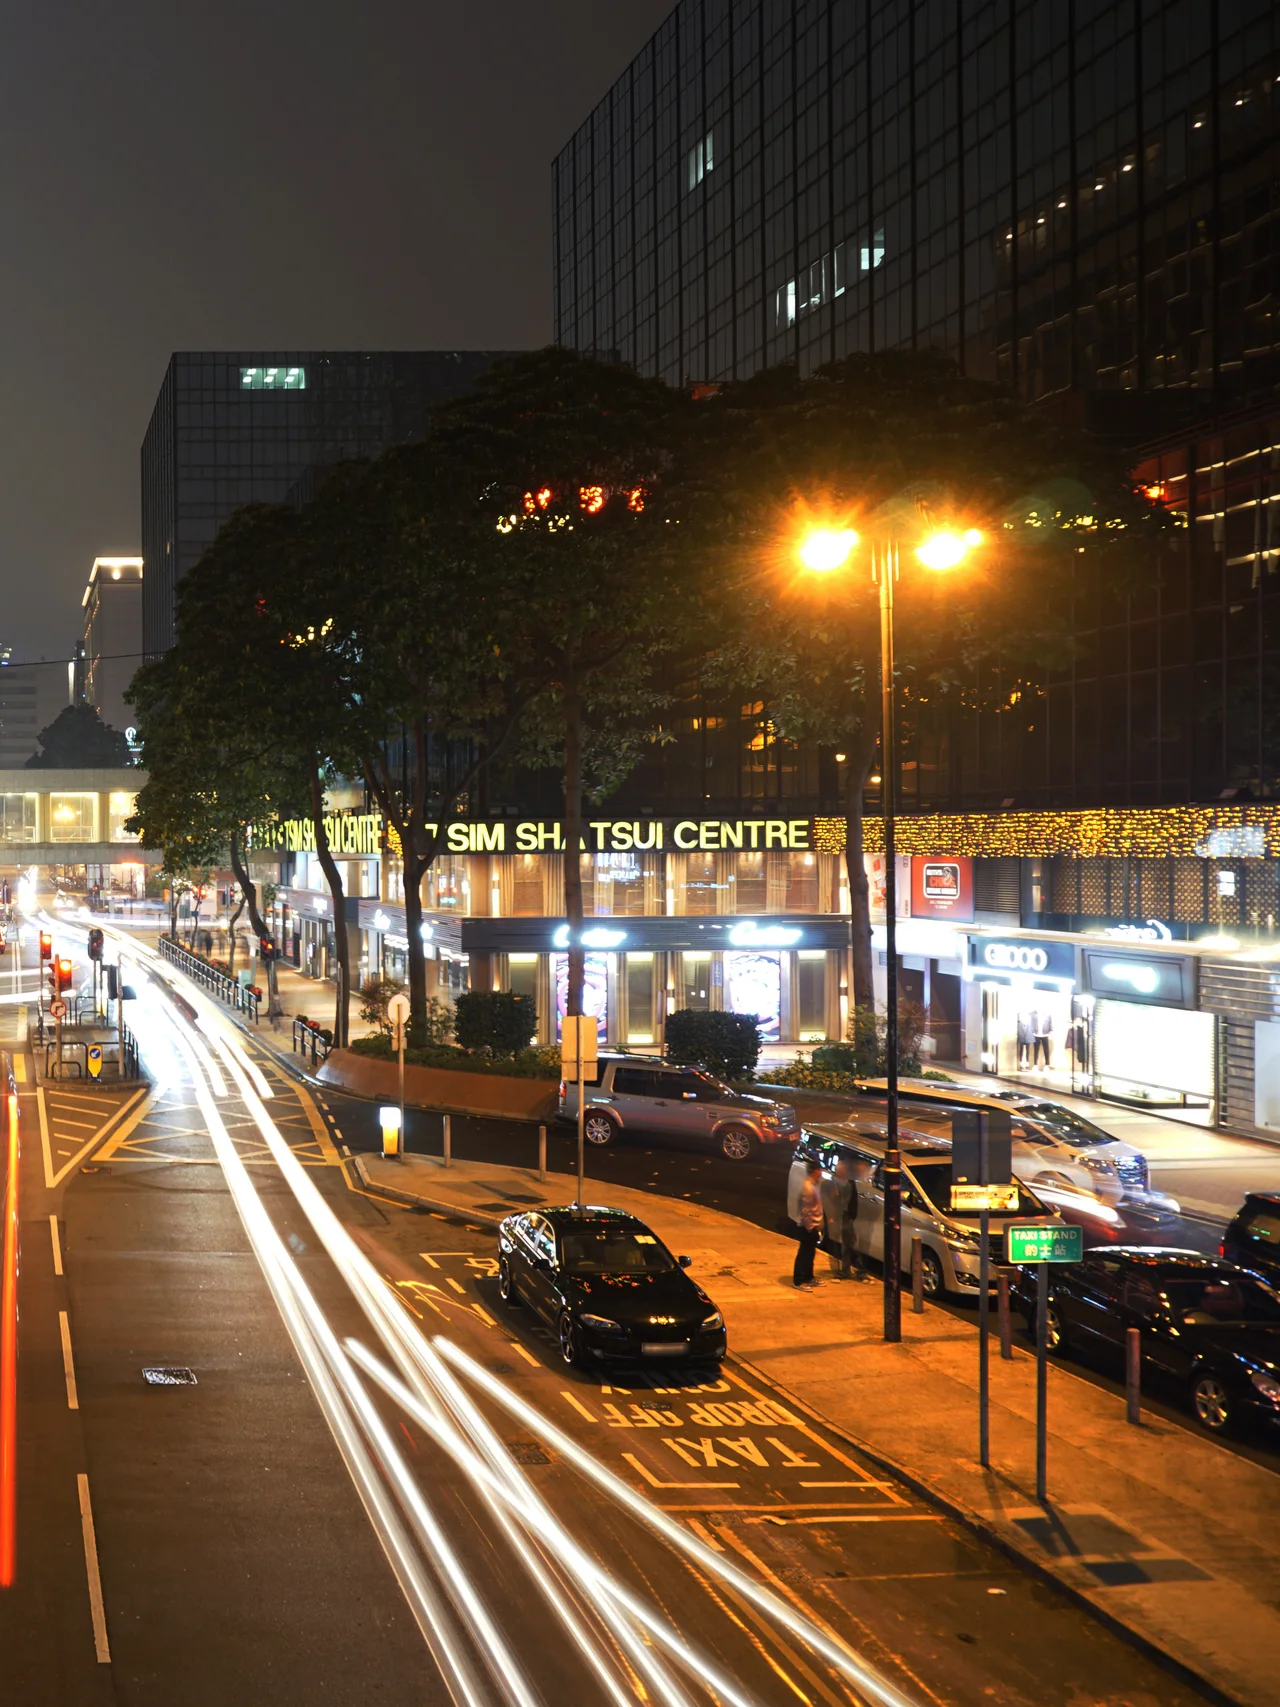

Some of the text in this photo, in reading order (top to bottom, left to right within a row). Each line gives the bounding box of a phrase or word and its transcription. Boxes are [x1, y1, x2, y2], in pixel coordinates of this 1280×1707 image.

[304, 817, 318, 852] SH
[342, 814, 383, 854] CENTRE
[516, 822, 586, 851] SH
[589, 821, 664, 850] TSUI
[673, 820, 810, 850] CENTRE
[984, 944, 1047, 971] G000
[1014, 1230, 1078, 1240] TAXI STAND
[1024, 1243, 1067, 1257] 的士站
[602, 1400, 806, 1428] DROP OFF
[661, 1436, 822, 1468] TAXI
